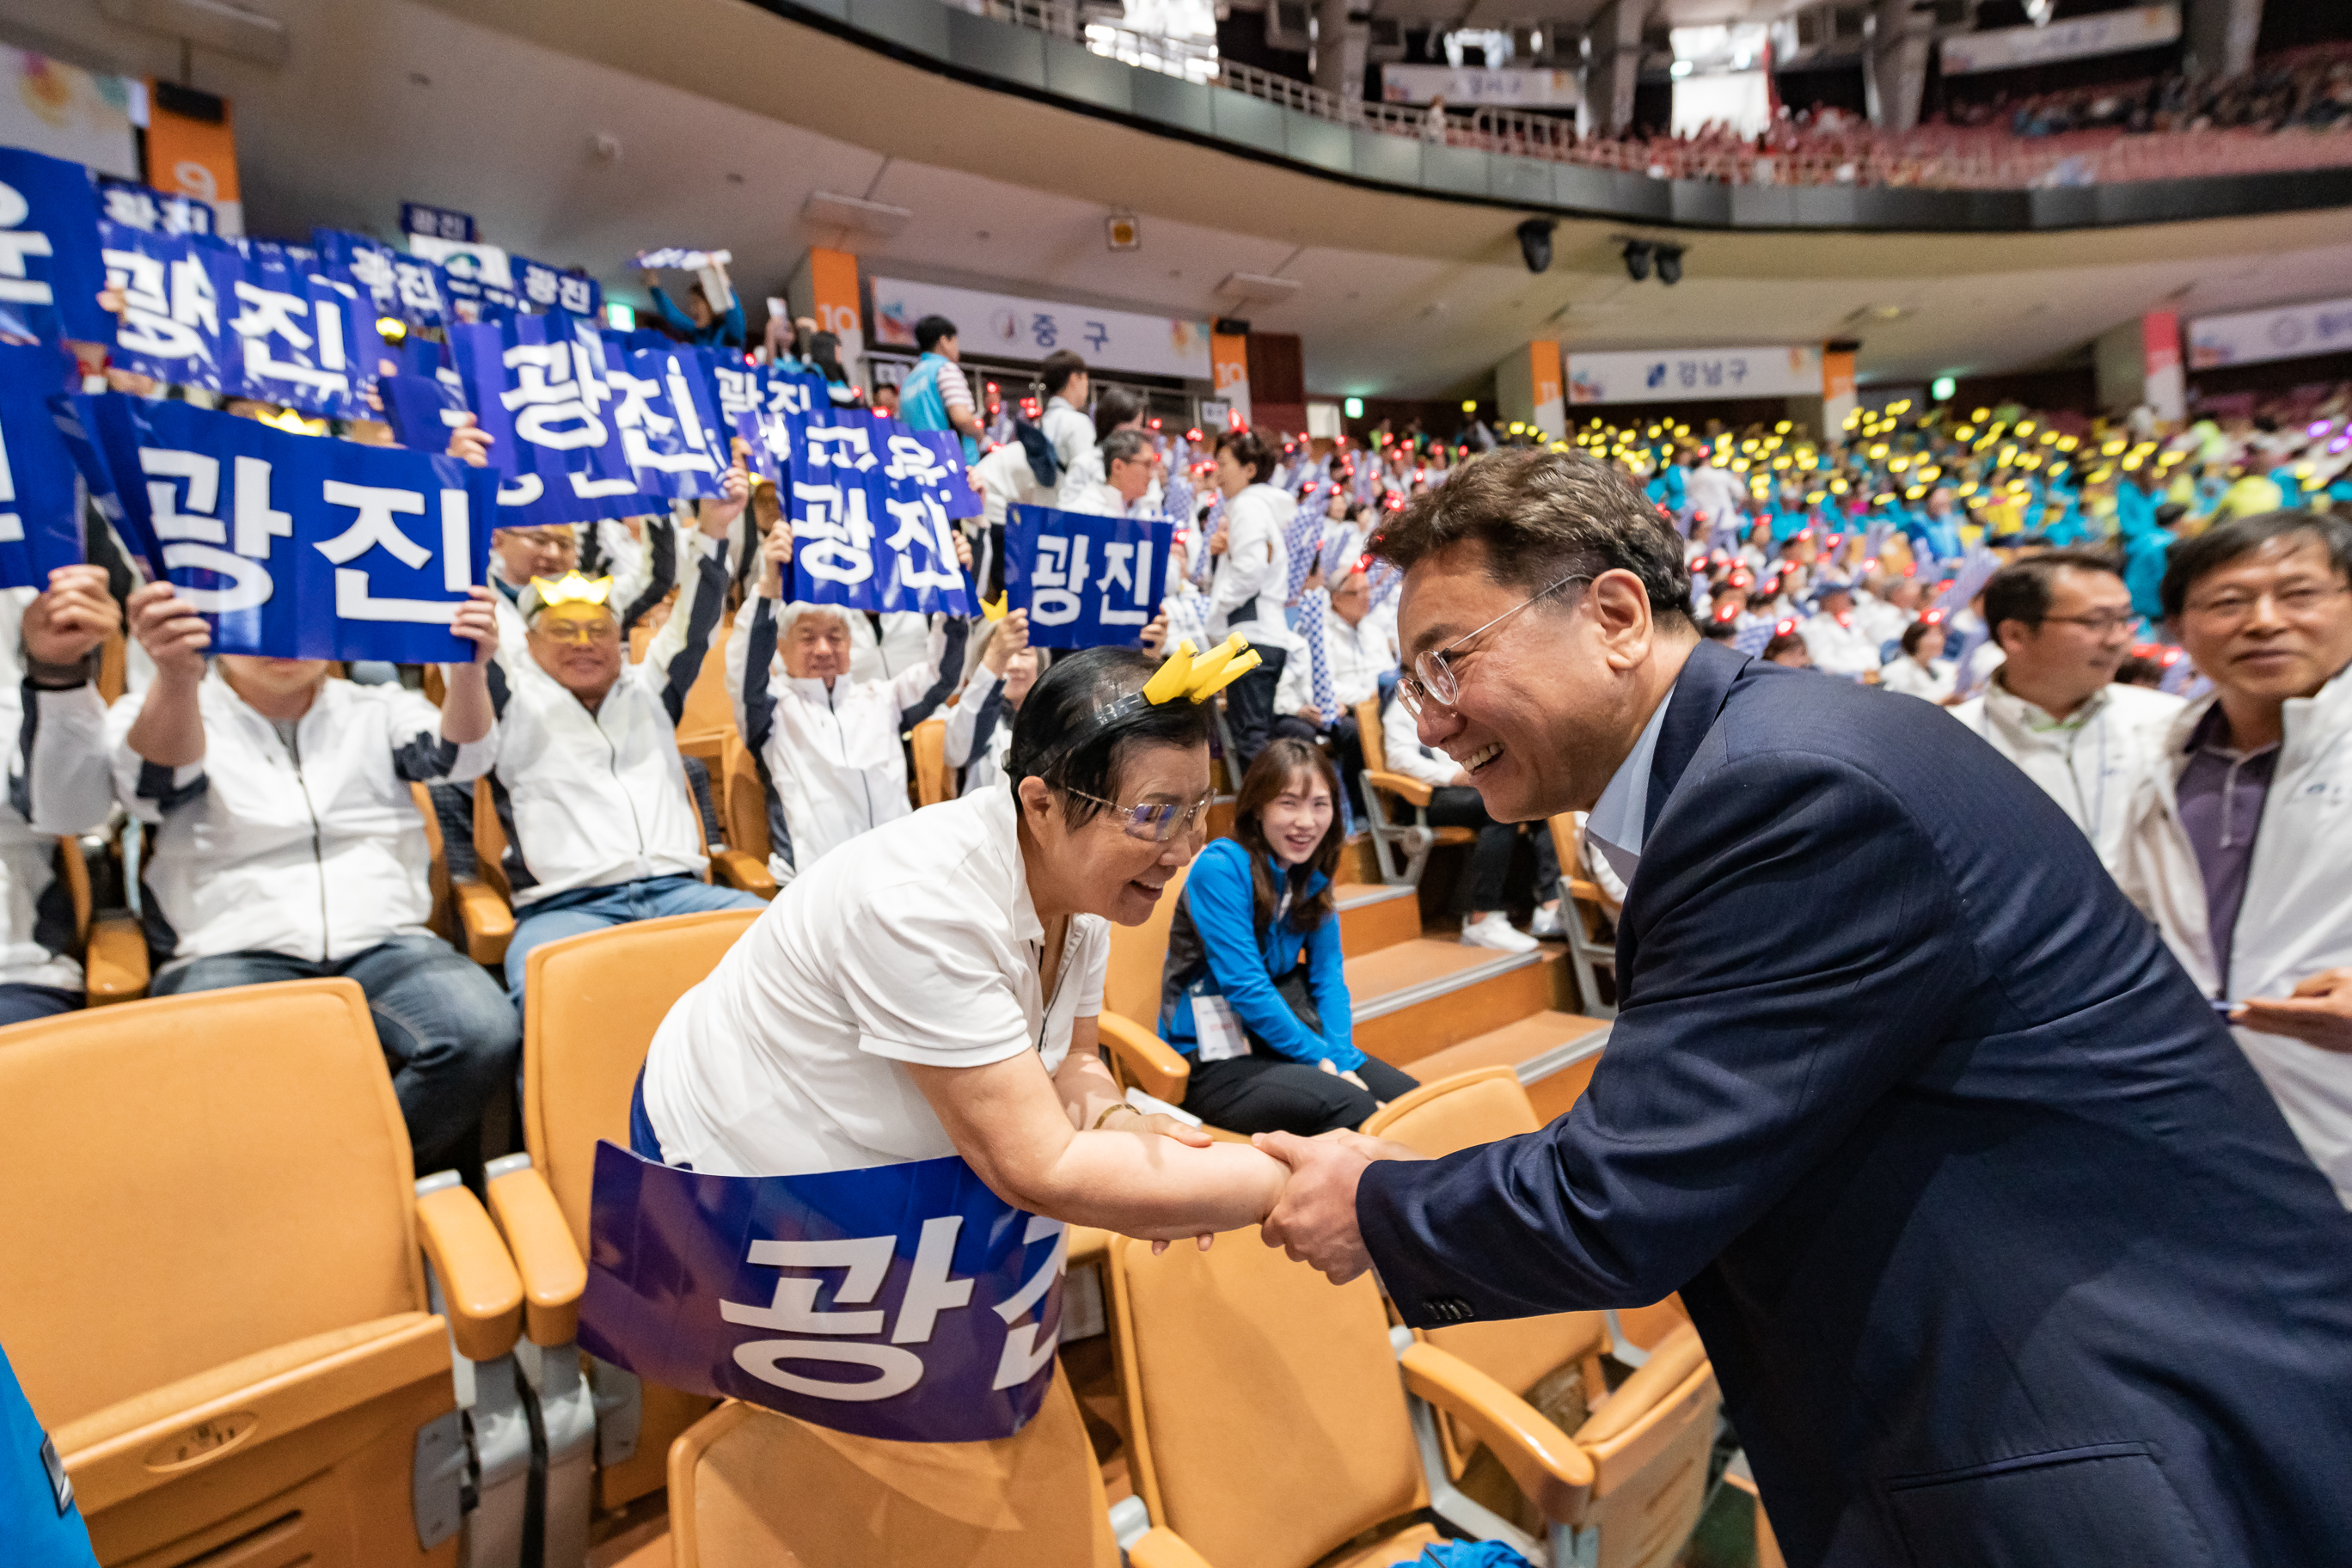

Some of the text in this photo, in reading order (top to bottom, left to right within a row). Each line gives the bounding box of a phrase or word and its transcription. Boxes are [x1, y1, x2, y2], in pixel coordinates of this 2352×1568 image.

[101, 248, 351, 402] 광진
[349, 246, 444, 313] 광진
[524, 264, 591, 315] 광진
[499, 340, 720, 475] 광진
[139, 446, 473, 625] 광진
[790, 480, 966, 593] 광진
[1031, 533, 1154, 627] 광진
